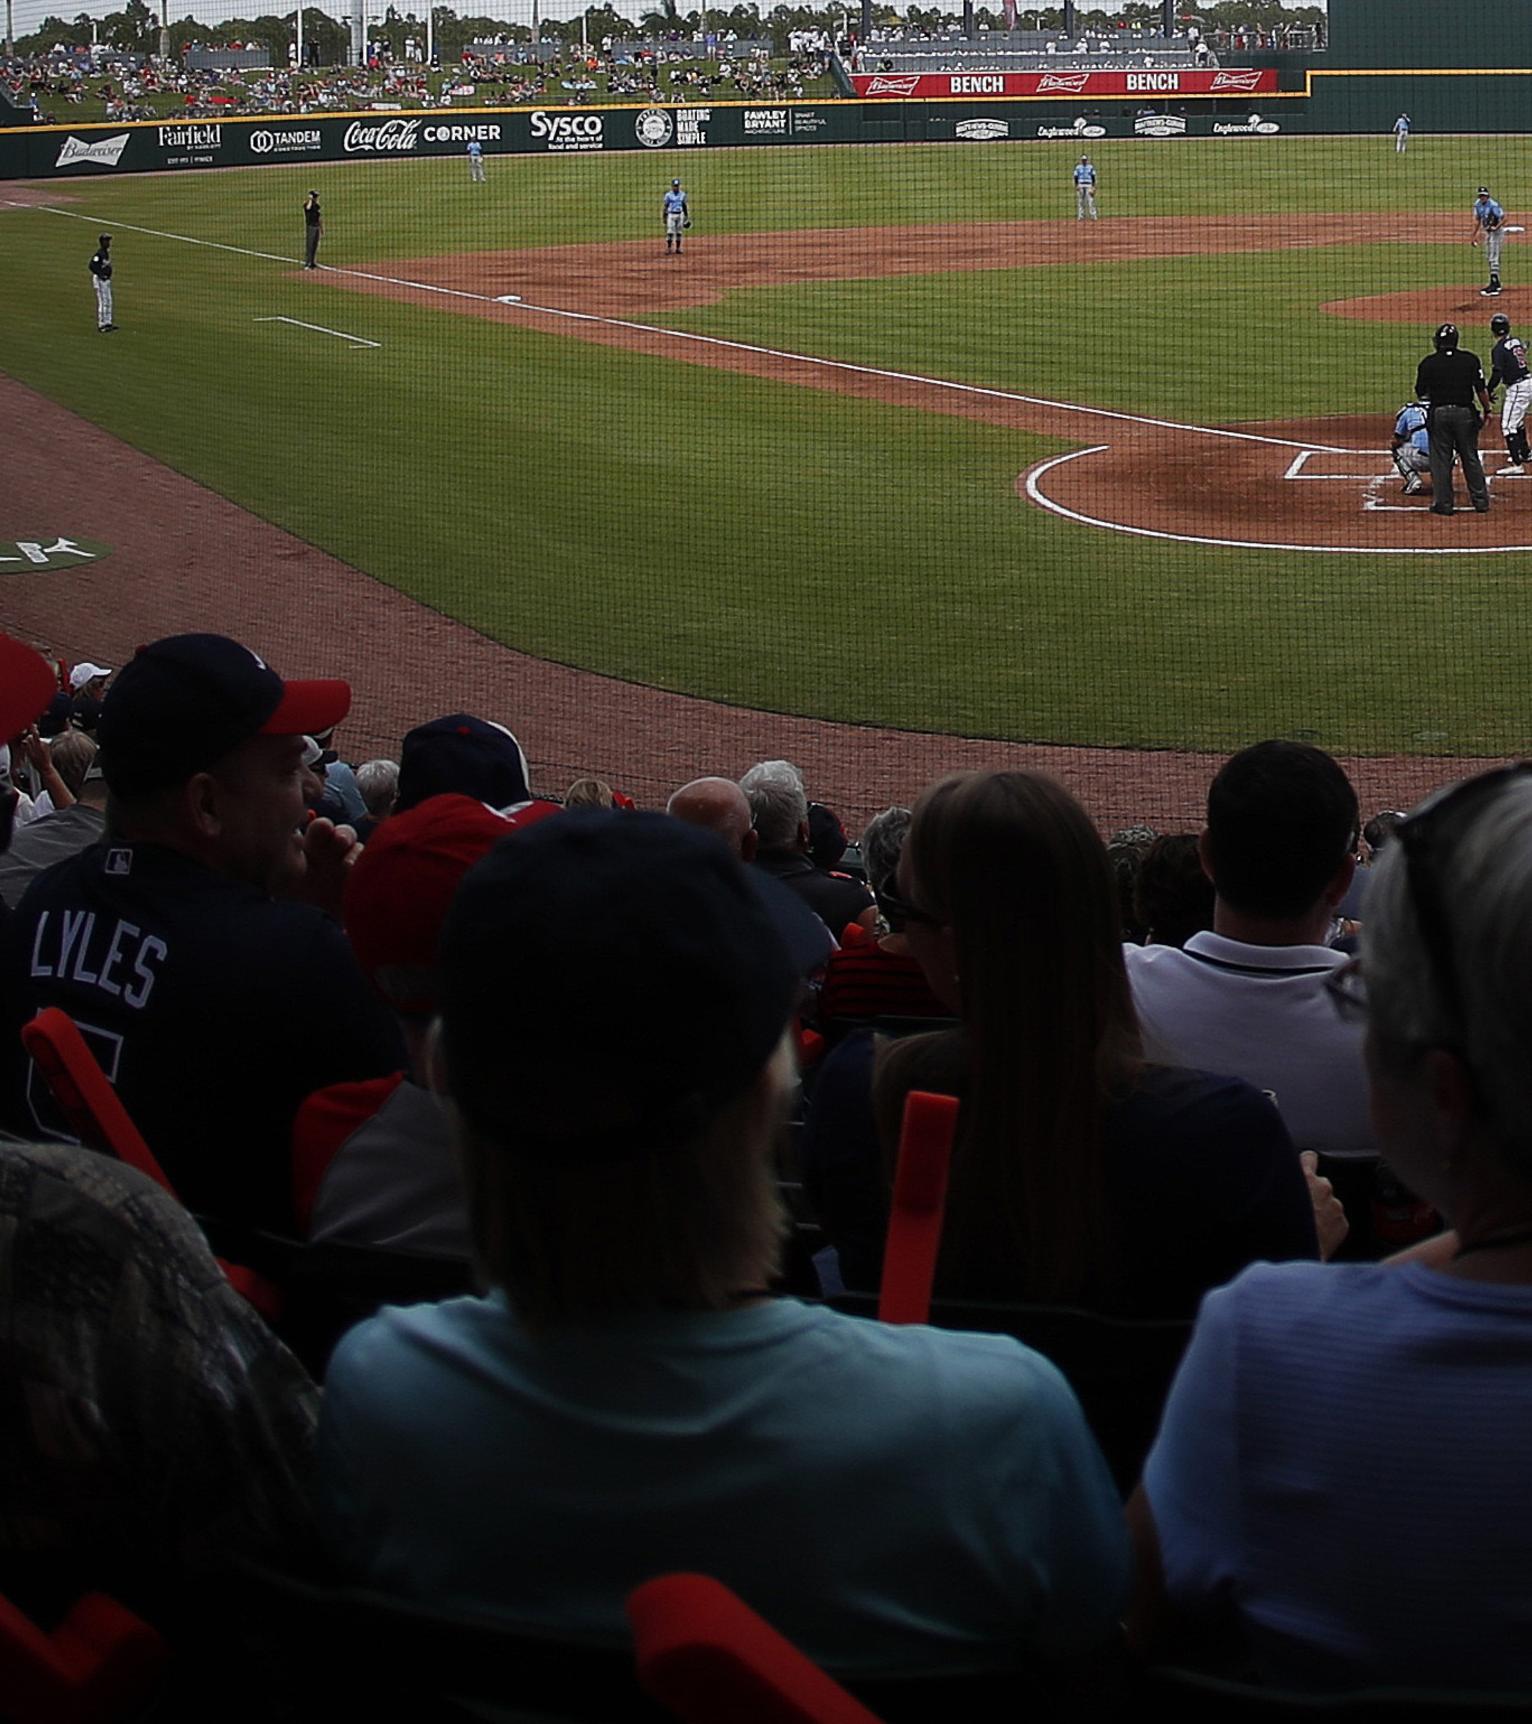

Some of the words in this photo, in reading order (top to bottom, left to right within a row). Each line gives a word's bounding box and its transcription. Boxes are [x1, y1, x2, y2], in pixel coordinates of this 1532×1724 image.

[950, 77, 1004, 93] BENCH
[1127, 74, 1179, 91] BENCH
[676, 109, 711, 122] BOATING
[744, 111, 787, 120] FAWLEY
[676, 121, 699, 133] MADE
[744, 119, 787, 129] BRYANT
[158, 125, 221, 147] Fairfield
[273, 130, 321, 144] TANDEM
[423, 125, 501, 142] CORNER
[676, 132, 707, 145] SIMPLE
[30, 909, 169, 1010] LYLES
